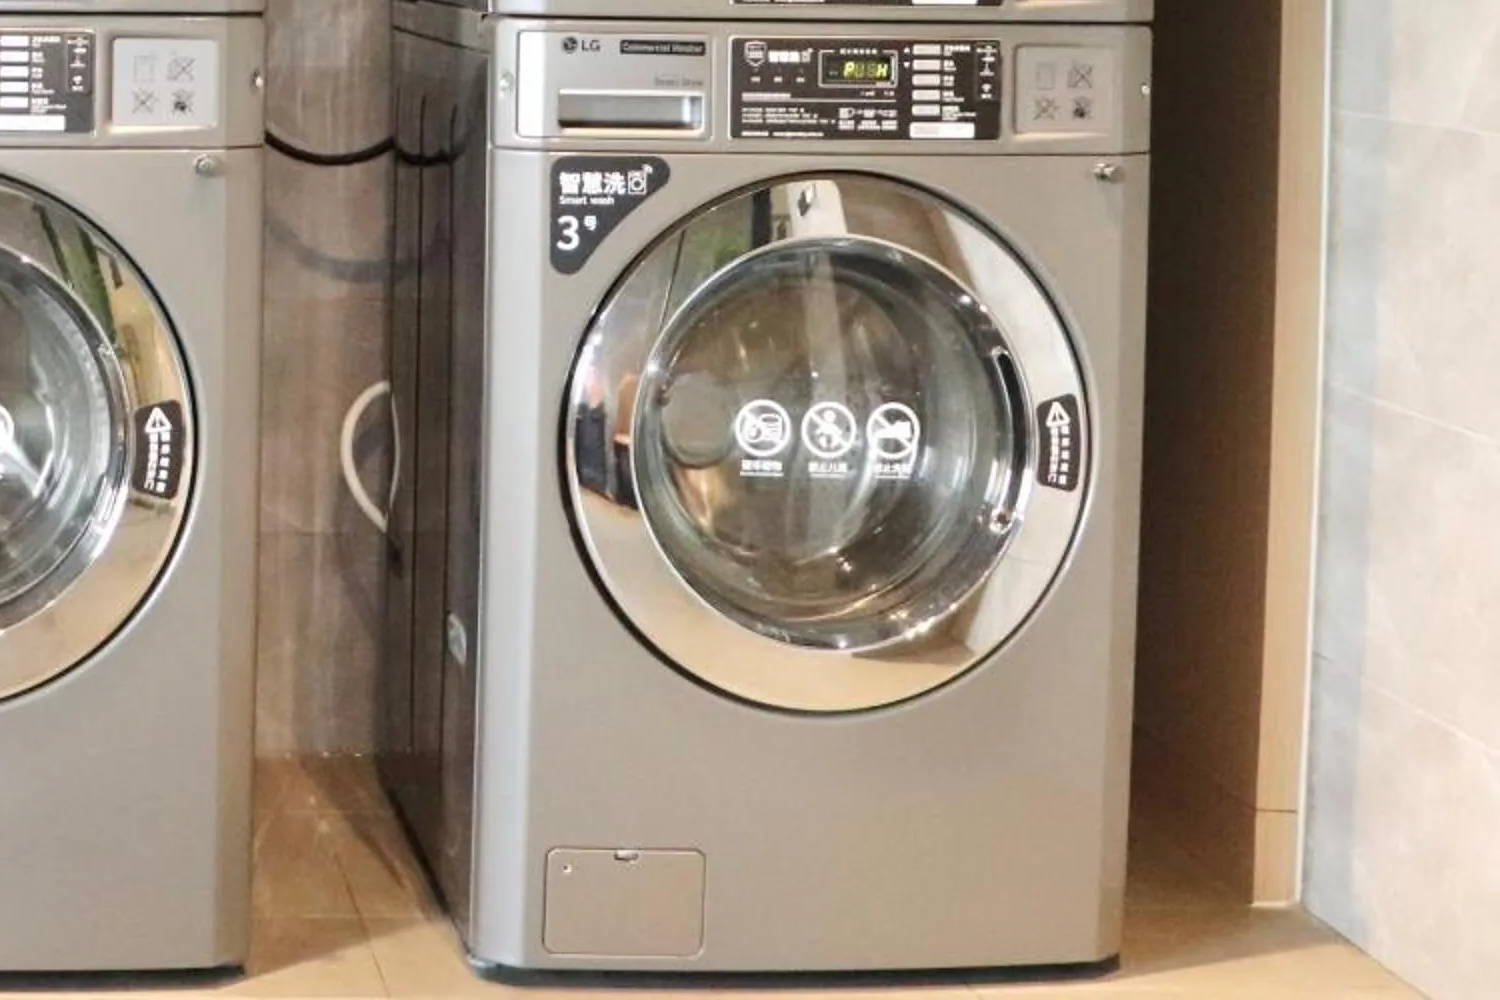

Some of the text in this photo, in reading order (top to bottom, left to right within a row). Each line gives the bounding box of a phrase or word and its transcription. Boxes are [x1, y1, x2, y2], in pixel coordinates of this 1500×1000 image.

[581, 39, 601, 52] LG
[559, 172, 626, 195] 智慧洗
